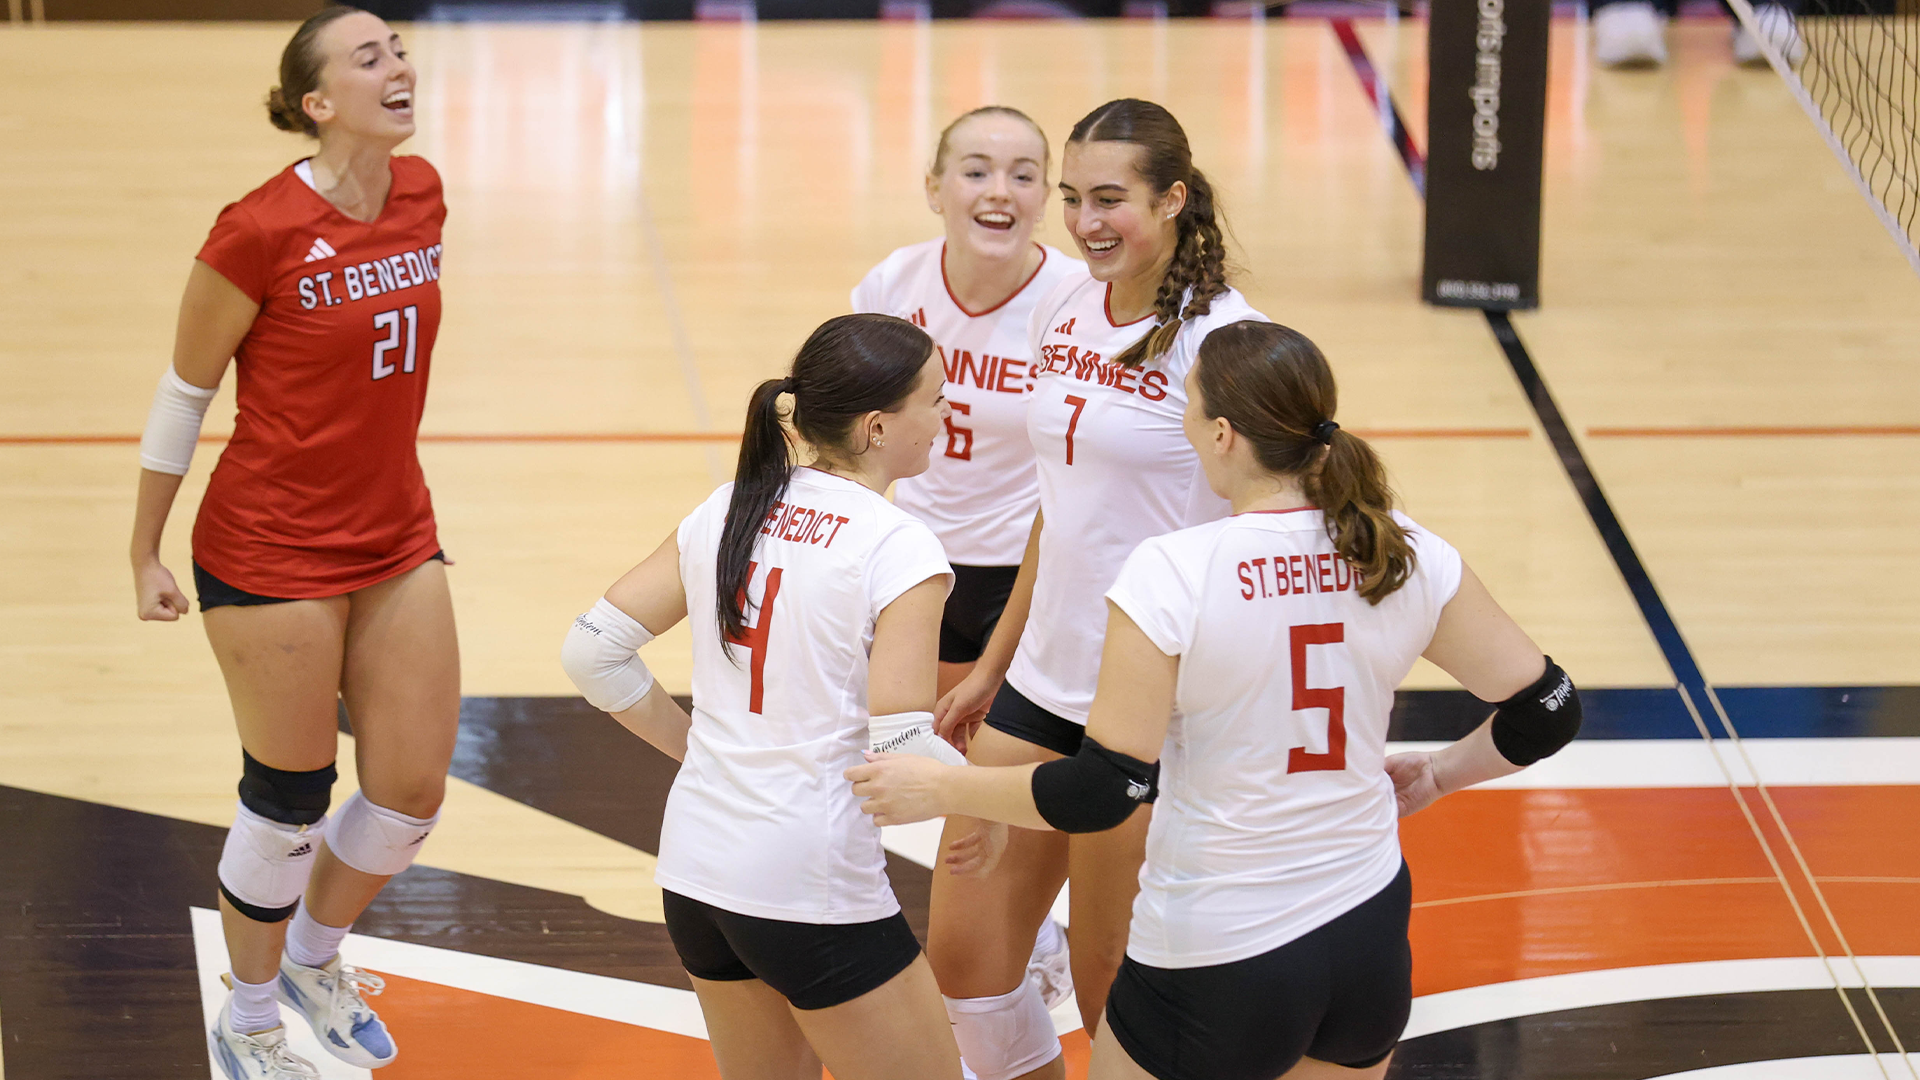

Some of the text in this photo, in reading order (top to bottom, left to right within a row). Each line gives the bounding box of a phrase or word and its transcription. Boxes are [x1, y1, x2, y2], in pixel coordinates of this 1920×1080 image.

[298, 271, 342, 310] ST.
[371, 305, 418, 381] 21
[937, 345, 1038, 394] NNIE
[944, 401, 974, 462] 6
[1063, 394, 1088, 466] 7
[760, 499, 851, 549] ENEDICT
[1237, 552, 1365, 601] ST. BENEDI
[725, 560, 784, 715] 4
[1286, 622, 1348, 775] 5
